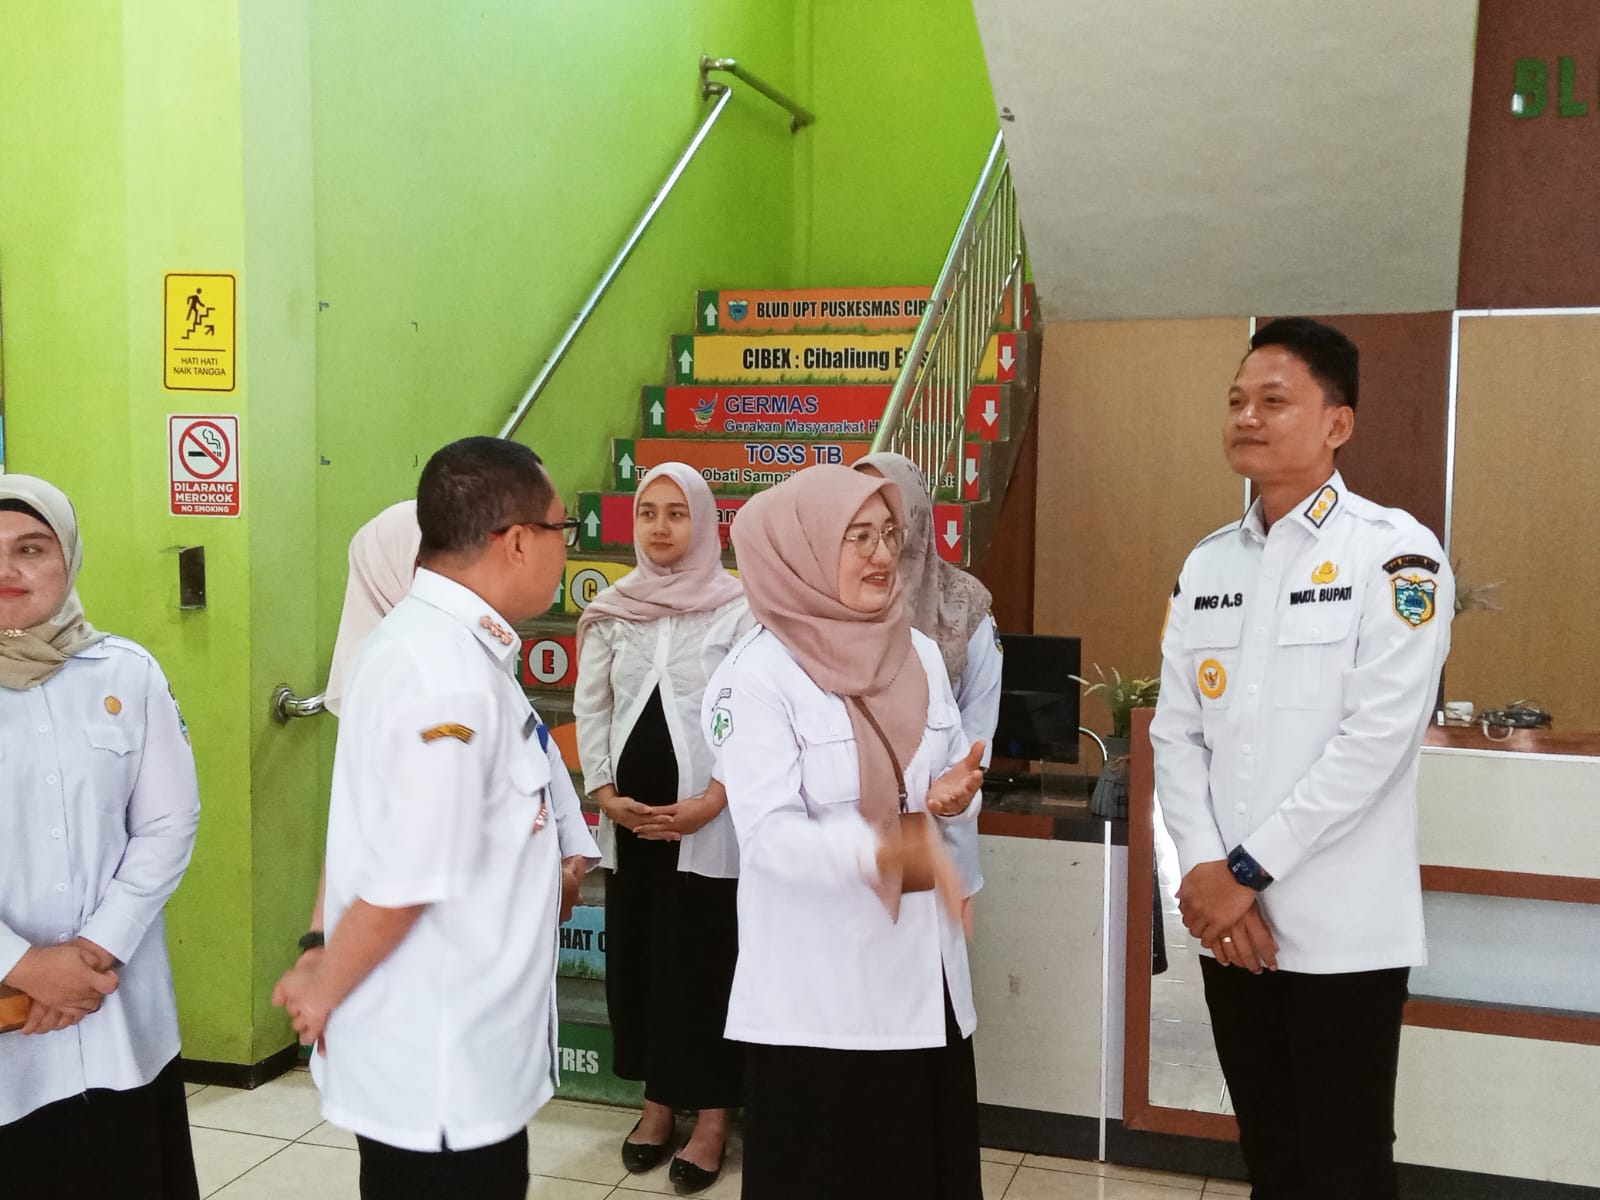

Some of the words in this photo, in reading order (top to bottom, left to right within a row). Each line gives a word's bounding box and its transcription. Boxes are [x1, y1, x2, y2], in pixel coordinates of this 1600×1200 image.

[757, 302, 789, 318] BLUD
[793, 302, 817, 317] UPT
[820, 300, 900, 317] PUSKESMAS
[181, 357, 199, 365] HATI
[200, 357, 218, 365] HATI
[743, 350, 791, 369] CIBEX
[804, 348, 889, 370] Cibaliung
[173, 367, 192, 375] NAIK
[193, 367, 226, 376] TANGGA
[725, 396, 818, 414] GERMAS
[724, 420, 781, 433] Gerakan
[785, 419, 864, 435] Masyarakat
[746, 445, 805, 464] TOSS
[813, 446, 842, 464] TB
[702, 468, 738, 482] Obati
[174, 482, 234, 493] DILARANG
[175, 493, 233, 503] MEROKOK
[194, 505, 229, 513] SMOKING
[542, 649, 555, 674] E
